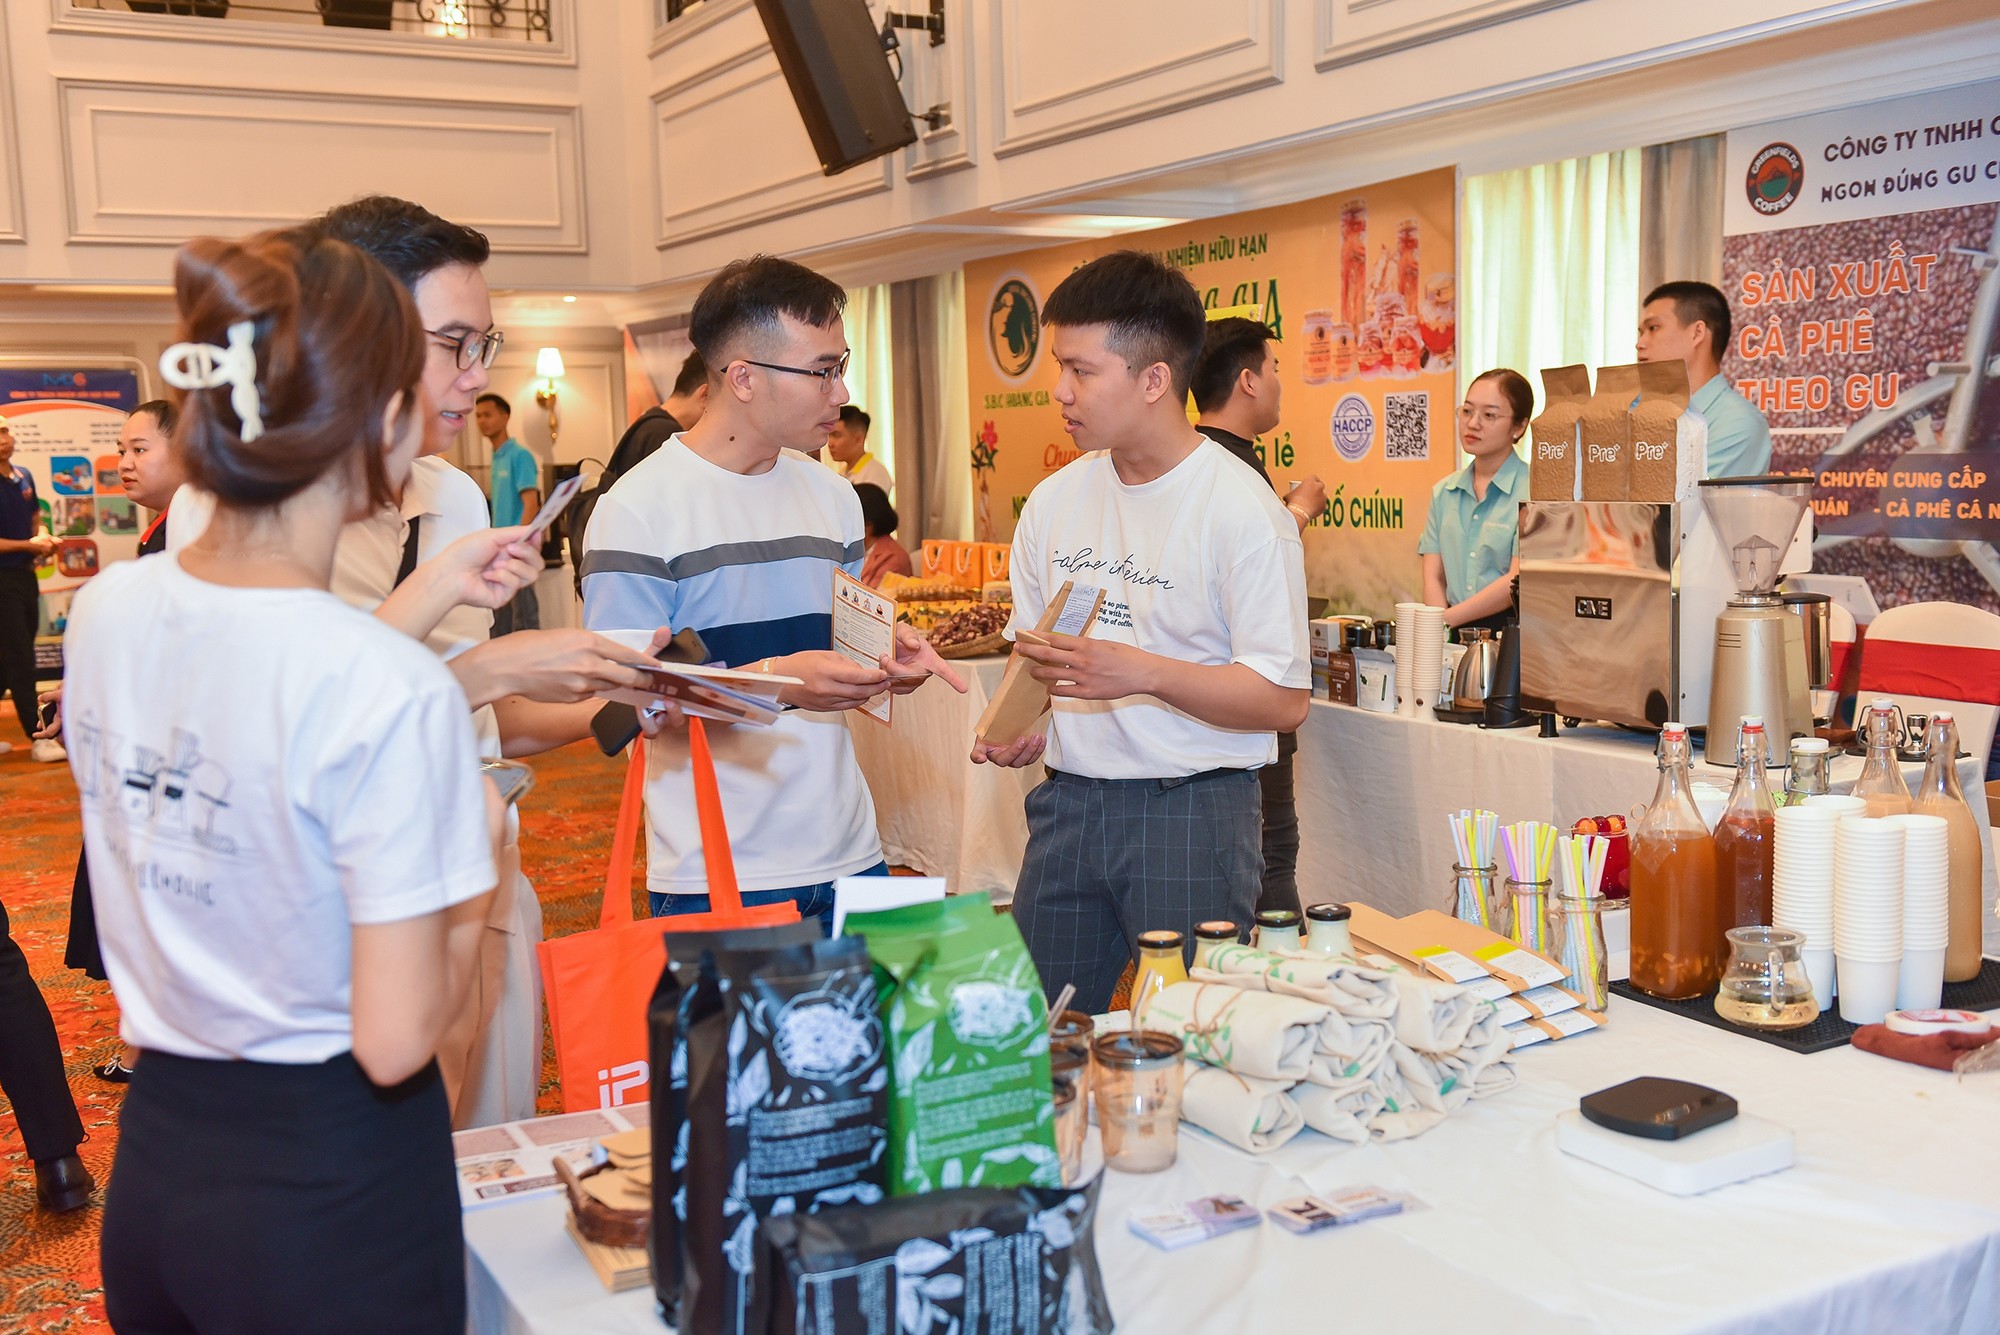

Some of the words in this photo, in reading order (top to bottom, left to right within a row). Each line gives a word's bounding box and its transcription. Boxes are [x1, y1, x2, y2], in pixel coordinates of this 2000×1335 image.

[1824, 136, 1888, 162] CÔNG
[1894, 130, 1918, 151] TY
[1924, 119, 1983, 146] TNHH
[1821, 179, 1876, 202] NGON
[1883, 168, 1938, 194] ĐÚNG
[1947, 164, 1976, 185] GU
[1985, 161, 2000, 179] C
[1754, 192, 1794, 213] COFFEE
[1239, 232, 1268, 262] HẠN
[1740, 257, 1816, 308] SẢN
[1827, 239, 1937, 300] XUẤT
[1739, 314, 1787, 361] CÀ
[1800, 307, 1874, 357] PHÊ
[1736, 375, 1831, 412] THEO
[1845, 372, 1899, 411] GU
[1333, 418, 1372, 433] HACCP
[1274, 431, 1295, 468] lẻ
[1820, 468, 1888, 488] CHUYÊN
[1893, 472, 1943, 488] CUNG
[1948, 465, 1987, 489] CẤP
[1323, 484, 1345, 528] BỐ
[1350, 488, 1403, 529] CHÍNH
[1809, 497, 1849, 516] UÁN
[1886, 498, 1911, 517] CÀ
[1915, 499, 1951, 518] PHÊ
[1957, 499, 1982, 519] CÁ
[1097, 615, 1110, 625] cup
[1110, 618, 1118, 626] of
[1108, 609, 1122, 618] with
[597, 1059, 650, 1109] iP
